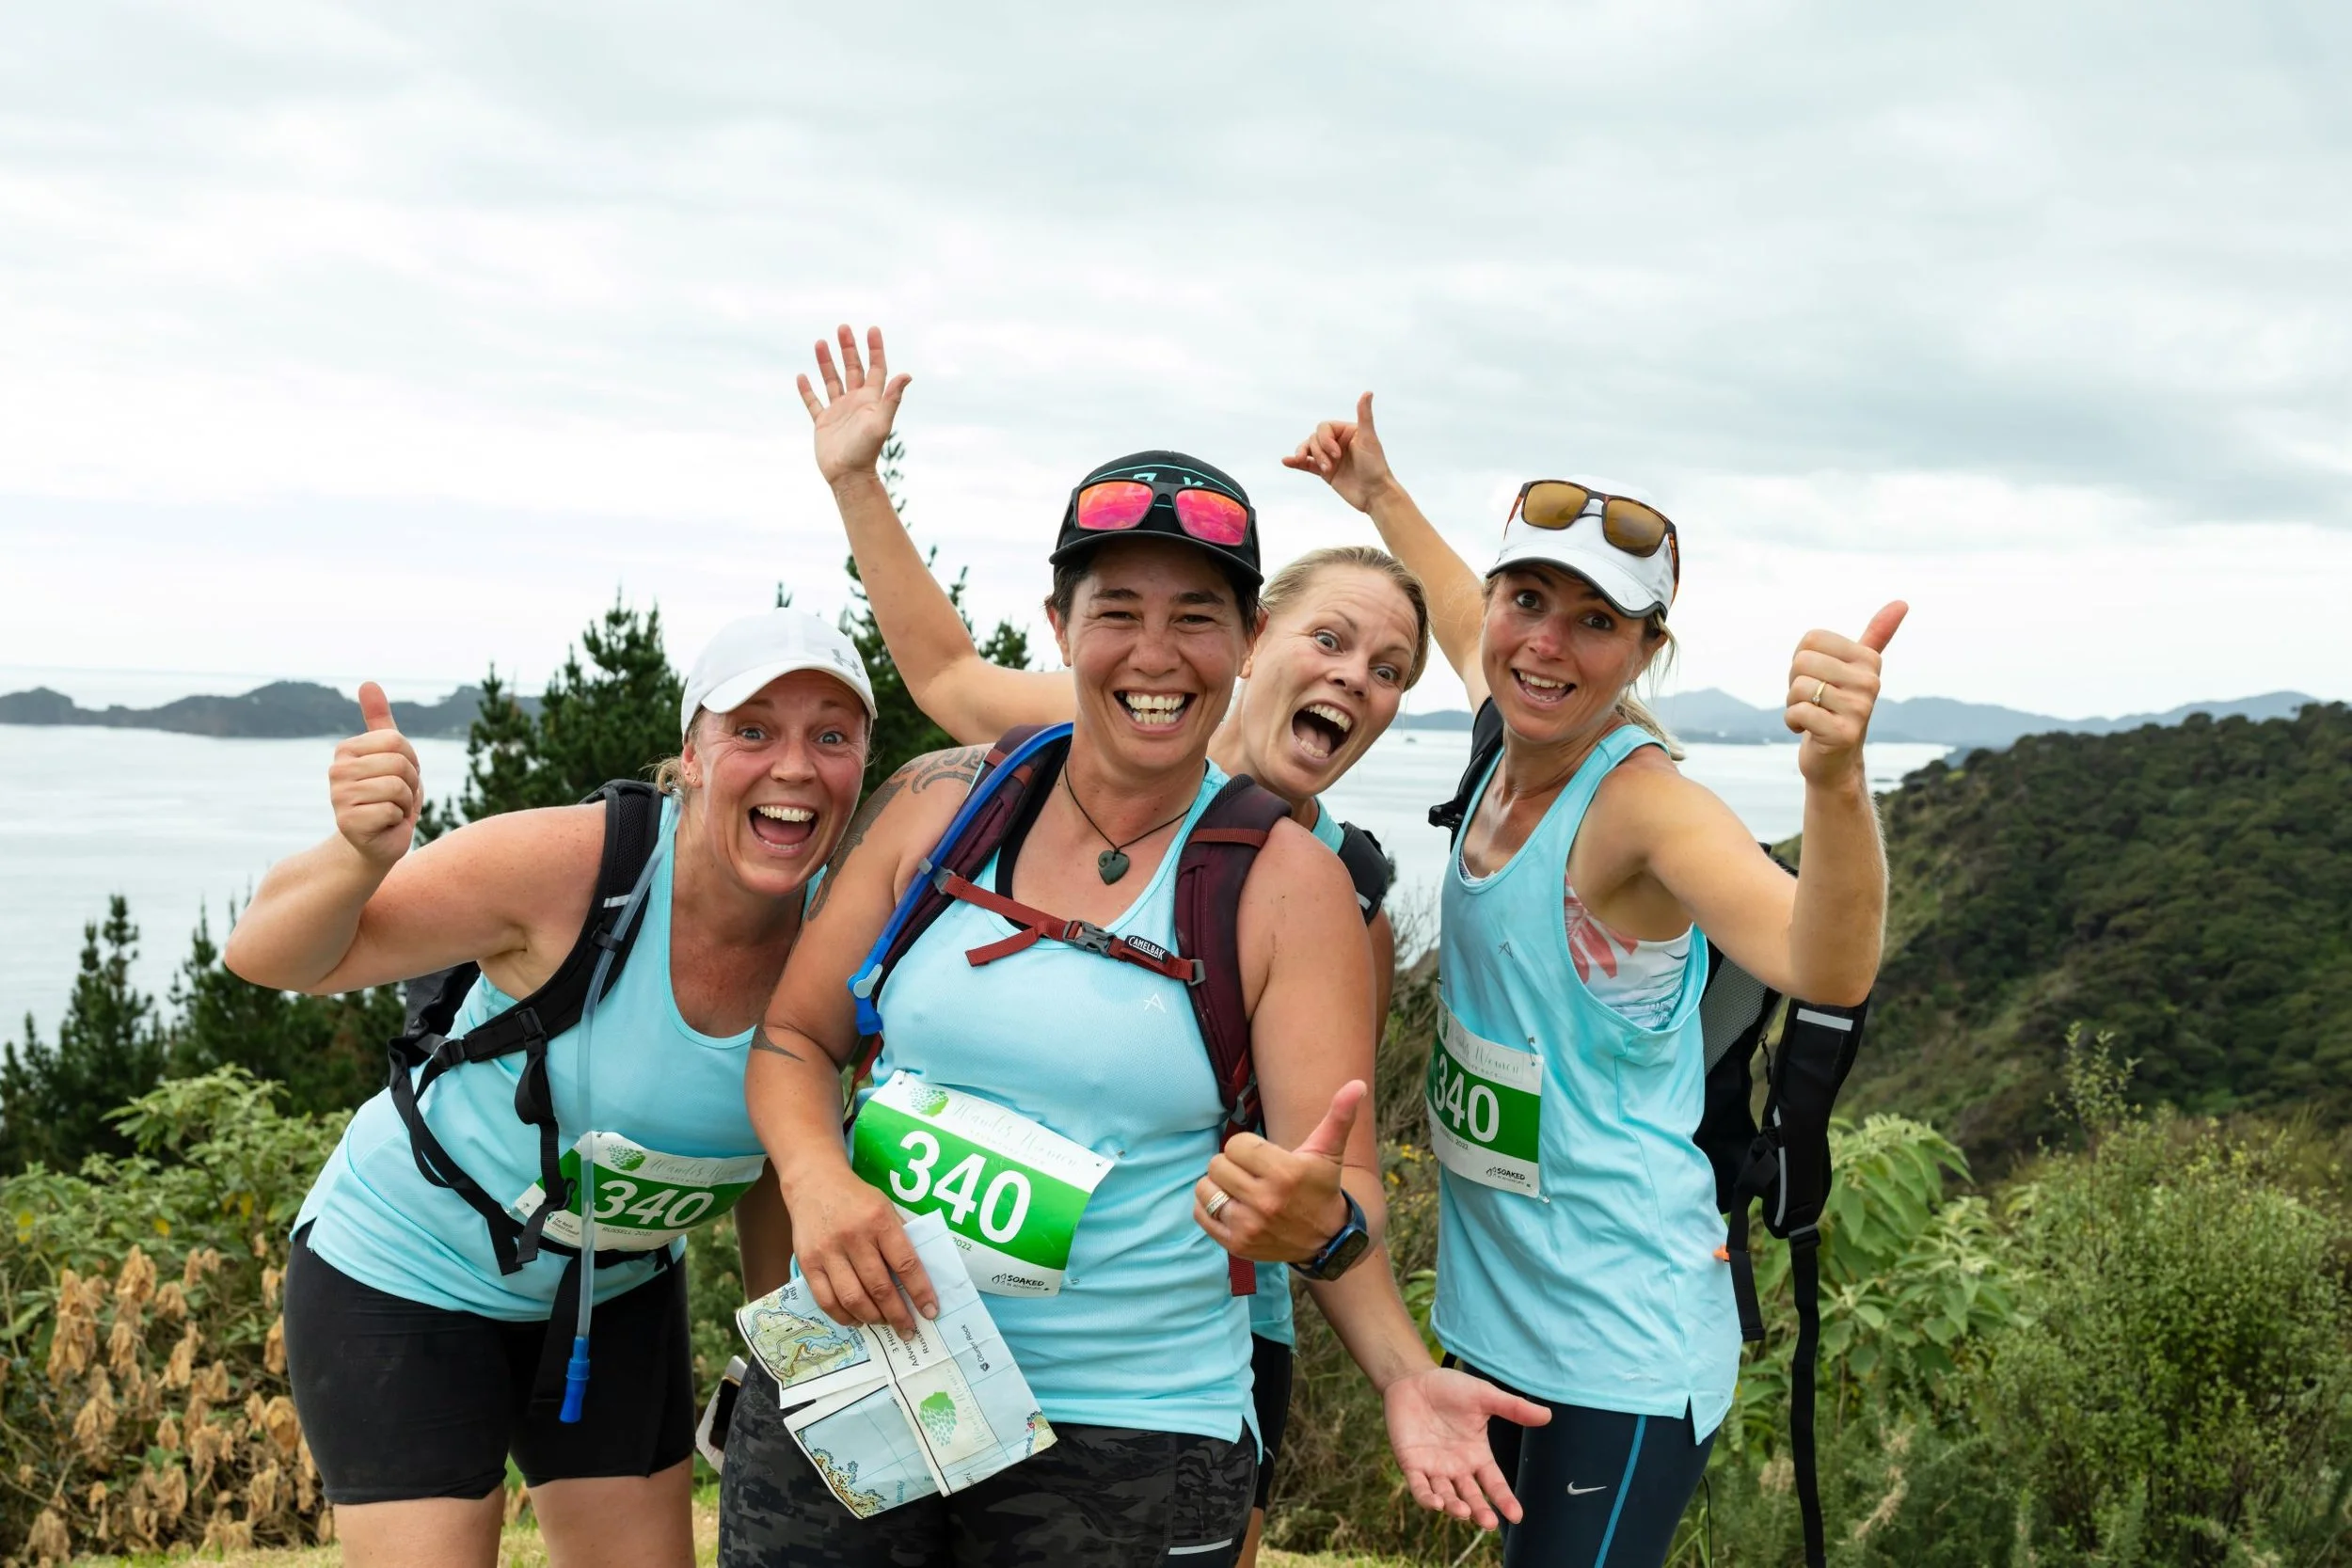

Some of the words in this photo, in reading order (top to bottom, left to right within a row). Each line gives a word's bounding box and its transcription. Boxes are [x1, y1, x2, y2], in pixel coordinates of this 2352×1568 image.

[1128, 935, 1166, 961] CAMELBAK
[1434, 1053, 1500, 1143] 340
[889, 1130, 1032, 1243] 340
[1497, 1167, 1525, 1181] SOAKED
[594, 1180, 715, 1227] 340
[1007, 1274, 1045, 1288] SOAKED
[882, 1325, 896, 1347] Hour
[914, 1323, 930, 1354] Russe
[903, 1338, 919, 1367] Adven
